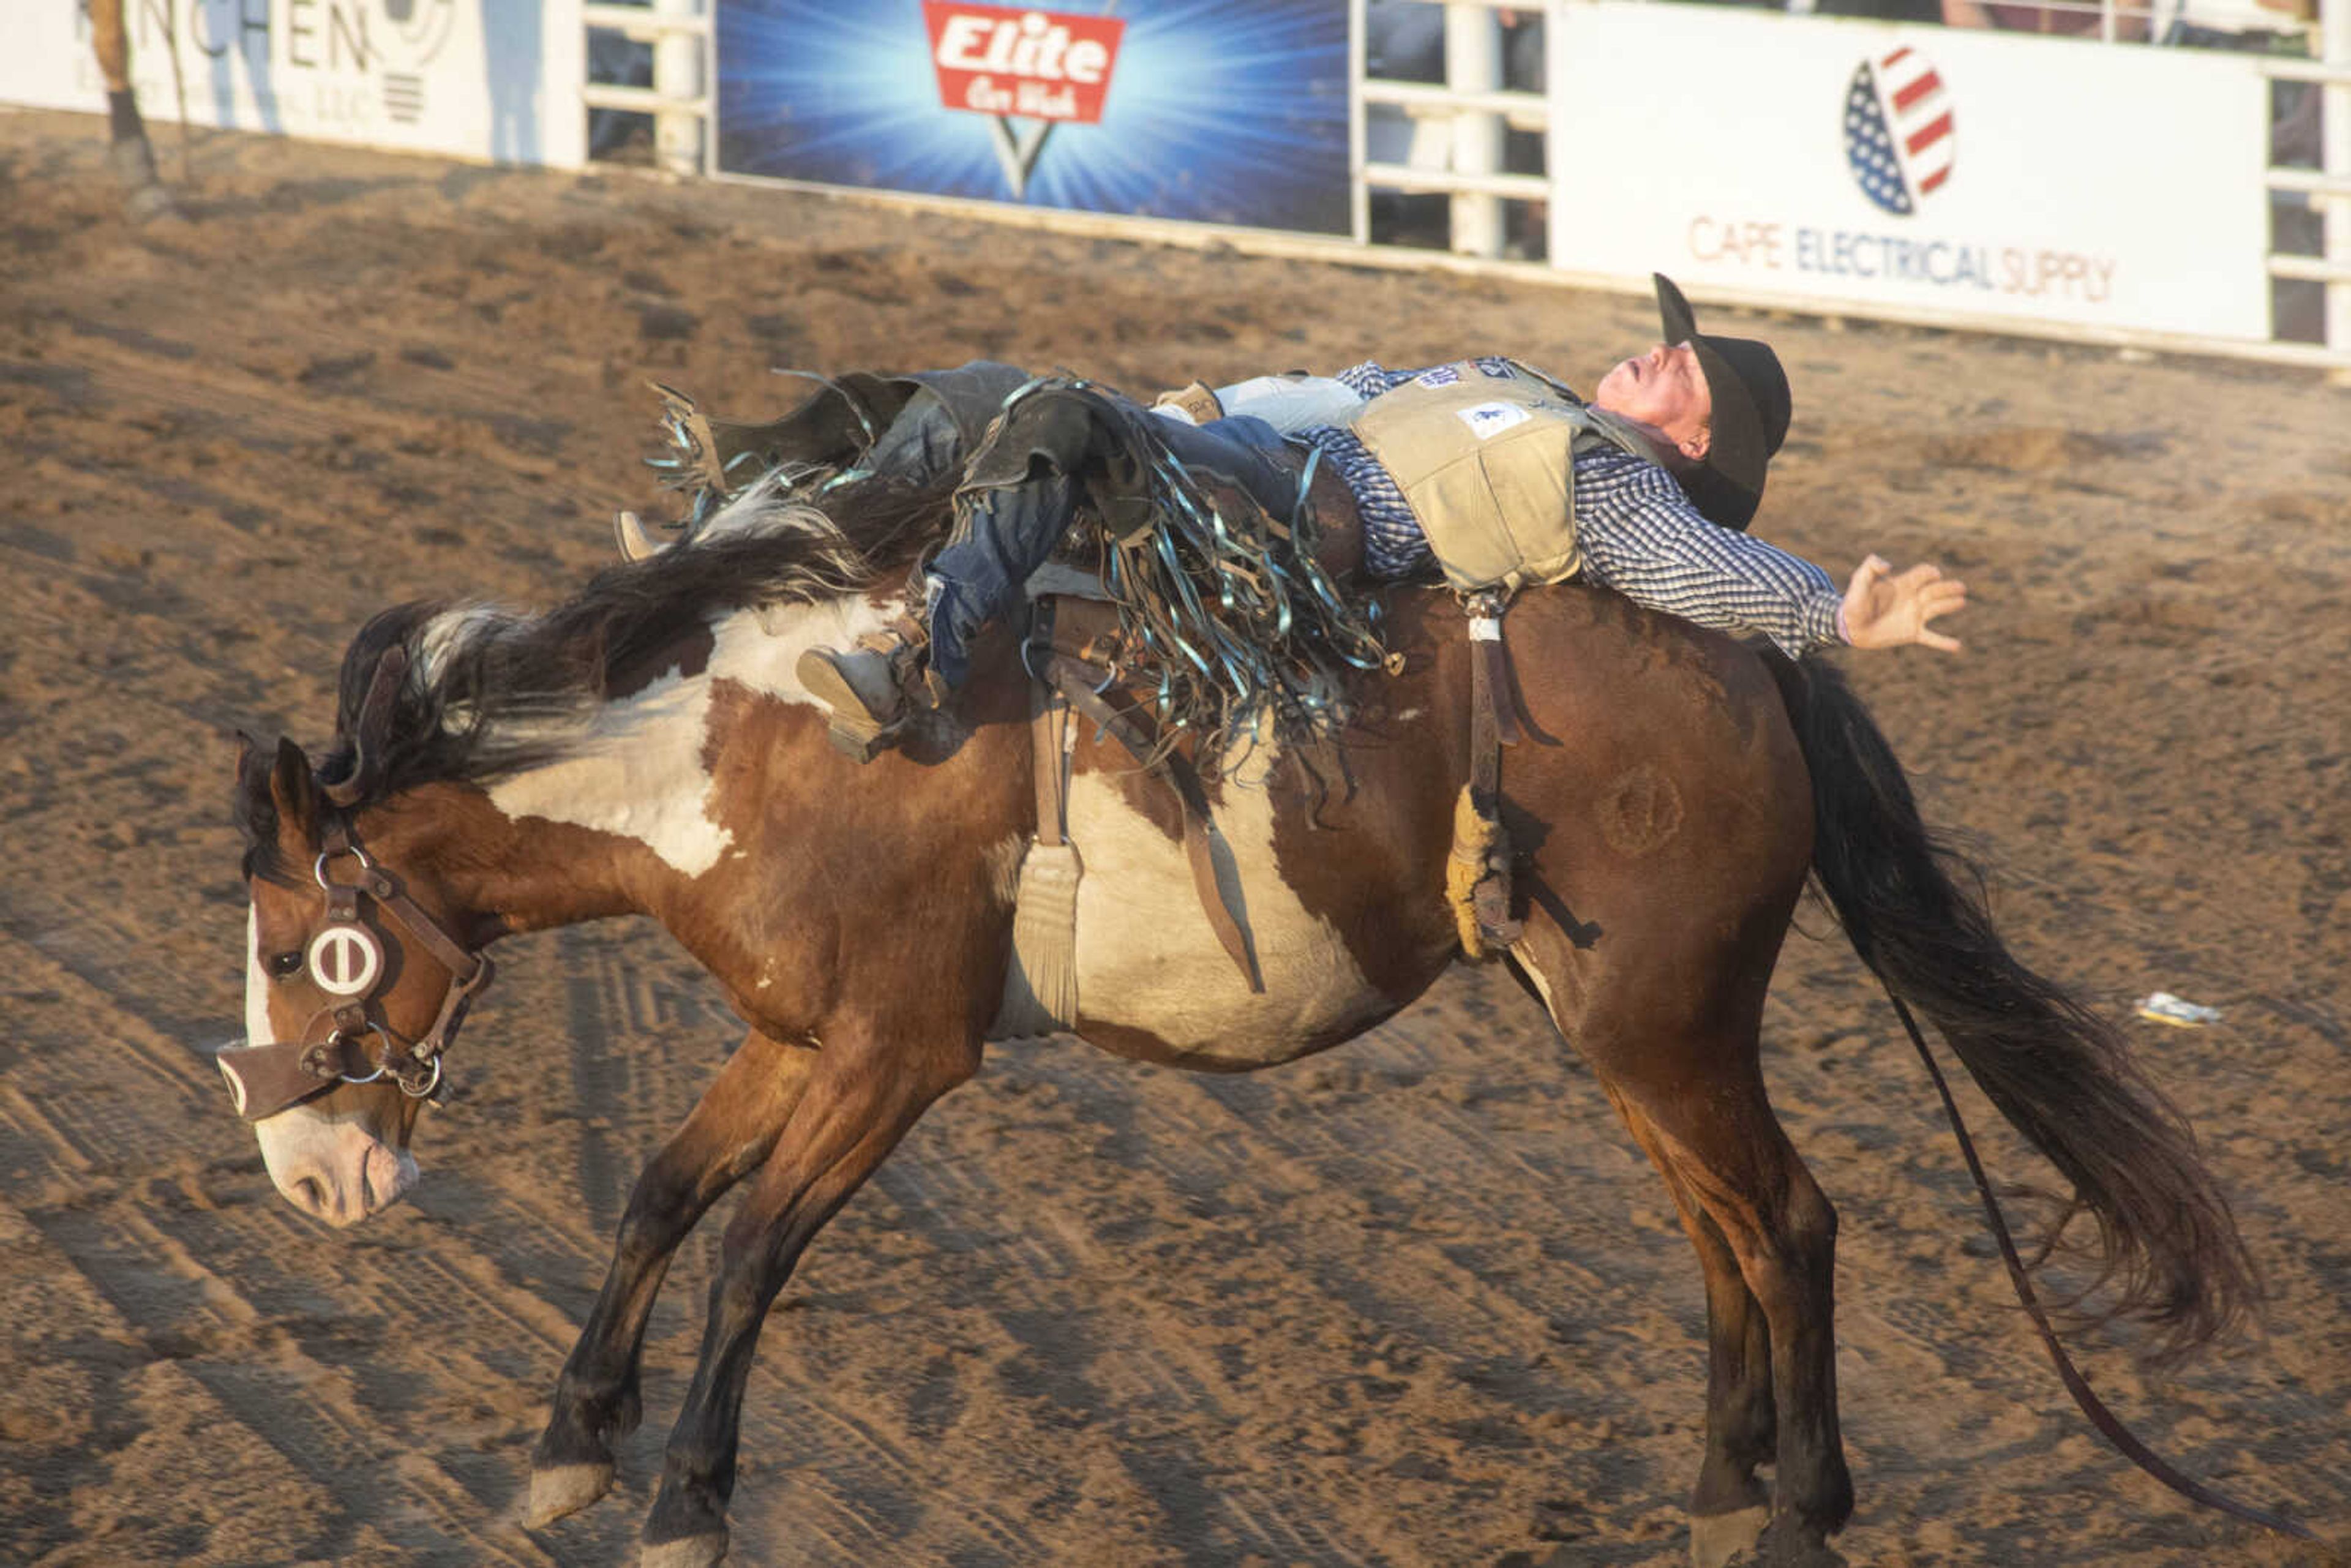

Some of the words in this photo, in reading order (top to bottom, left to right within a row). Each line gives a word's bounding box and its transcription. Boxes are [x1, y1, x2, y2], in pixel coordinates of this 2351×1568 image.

[937, 11, 1108, 84] Elite
[1687, 216, 1782, 269] CAPE
[1796, 227, 1993, 290] ELECTRICAL
[2001, 246, 2117, 303] SUPPLY
